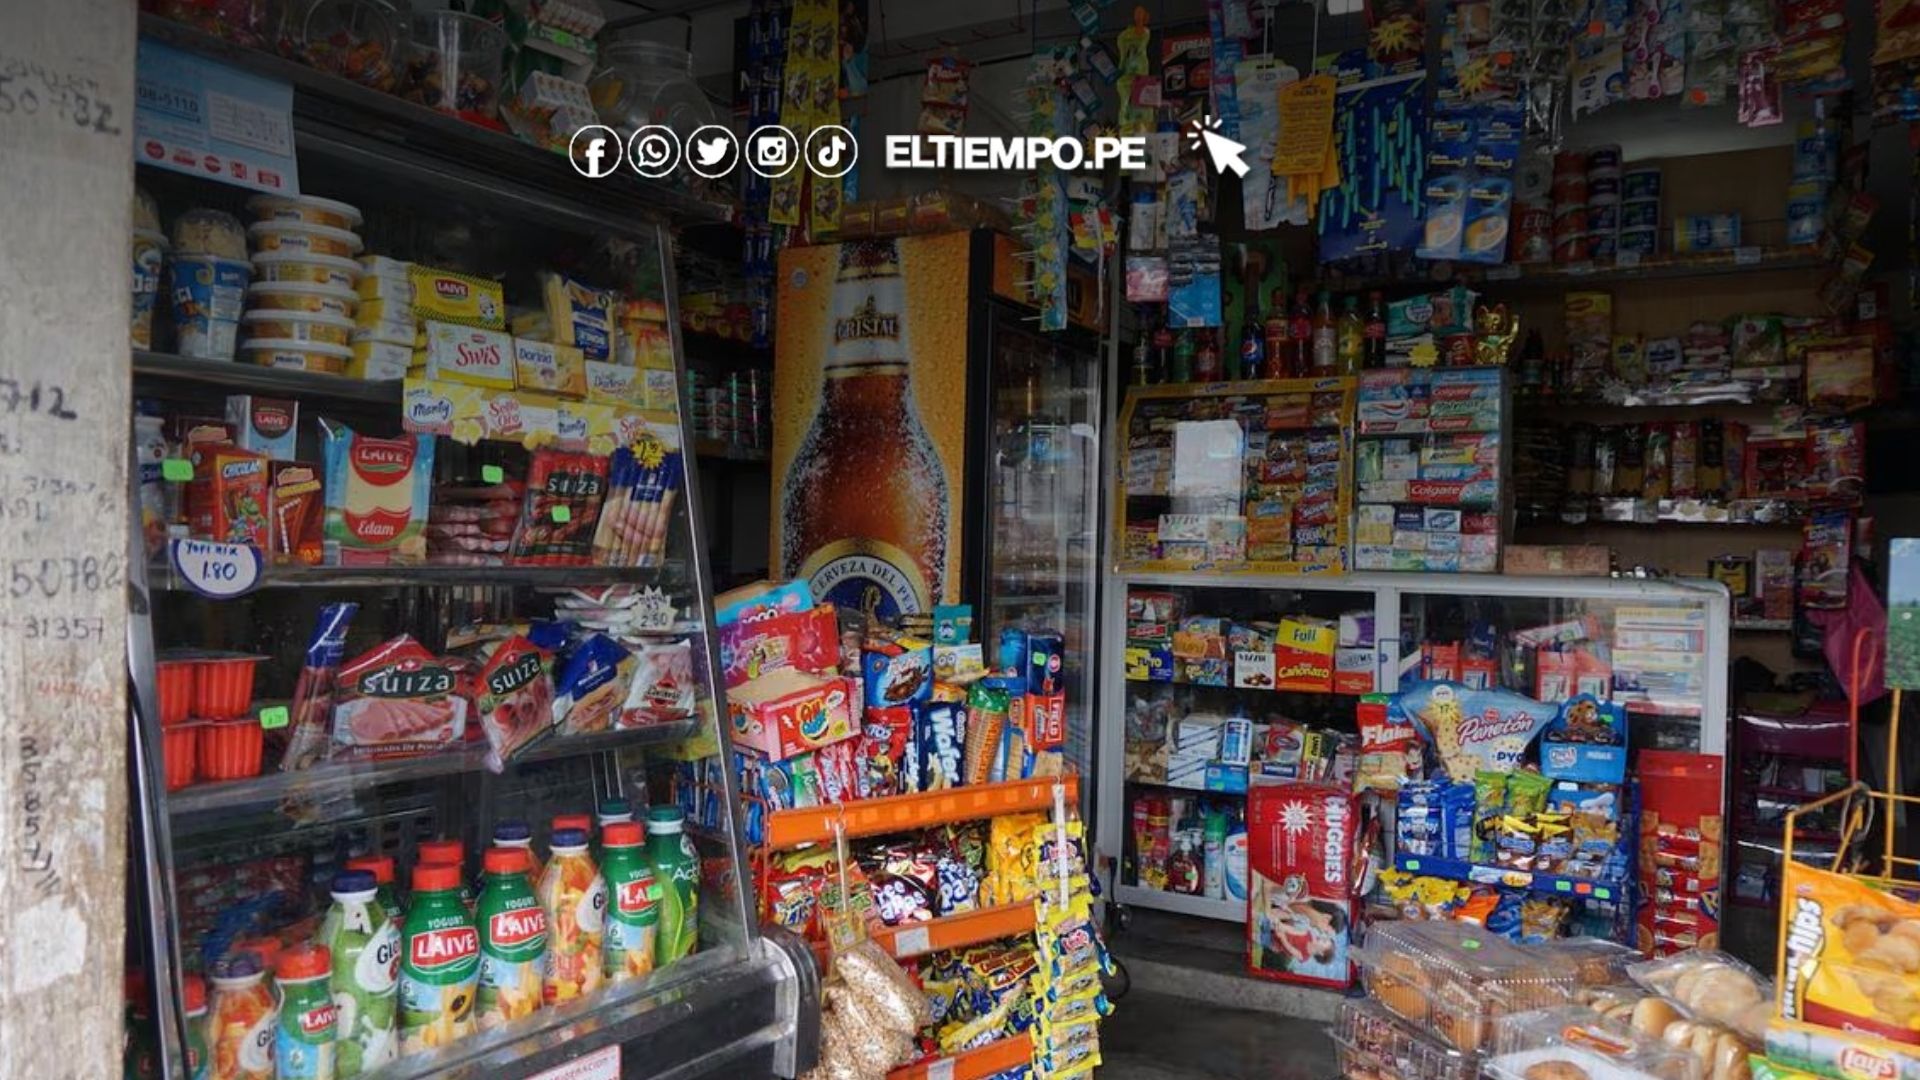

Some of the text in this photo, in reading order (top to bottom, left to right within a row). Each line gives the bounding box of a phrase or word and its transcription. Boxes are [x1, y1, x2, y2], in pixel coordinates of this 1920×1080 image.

[361, 451, 405, 465] LAIVE
[1410, 484, 1462, 498] Colgate
[357, 518, 394, 536] Edam
[812, 560, 866, 597] CERVEZA
[873, 563, 895, 585] DEL
[362, 674, 452, 695] suiza
[491, 657, 541, 696] suiza
[1323, 795, 1350, 884] HUGGIES
[417, 931, 477, 960] LAIVE
